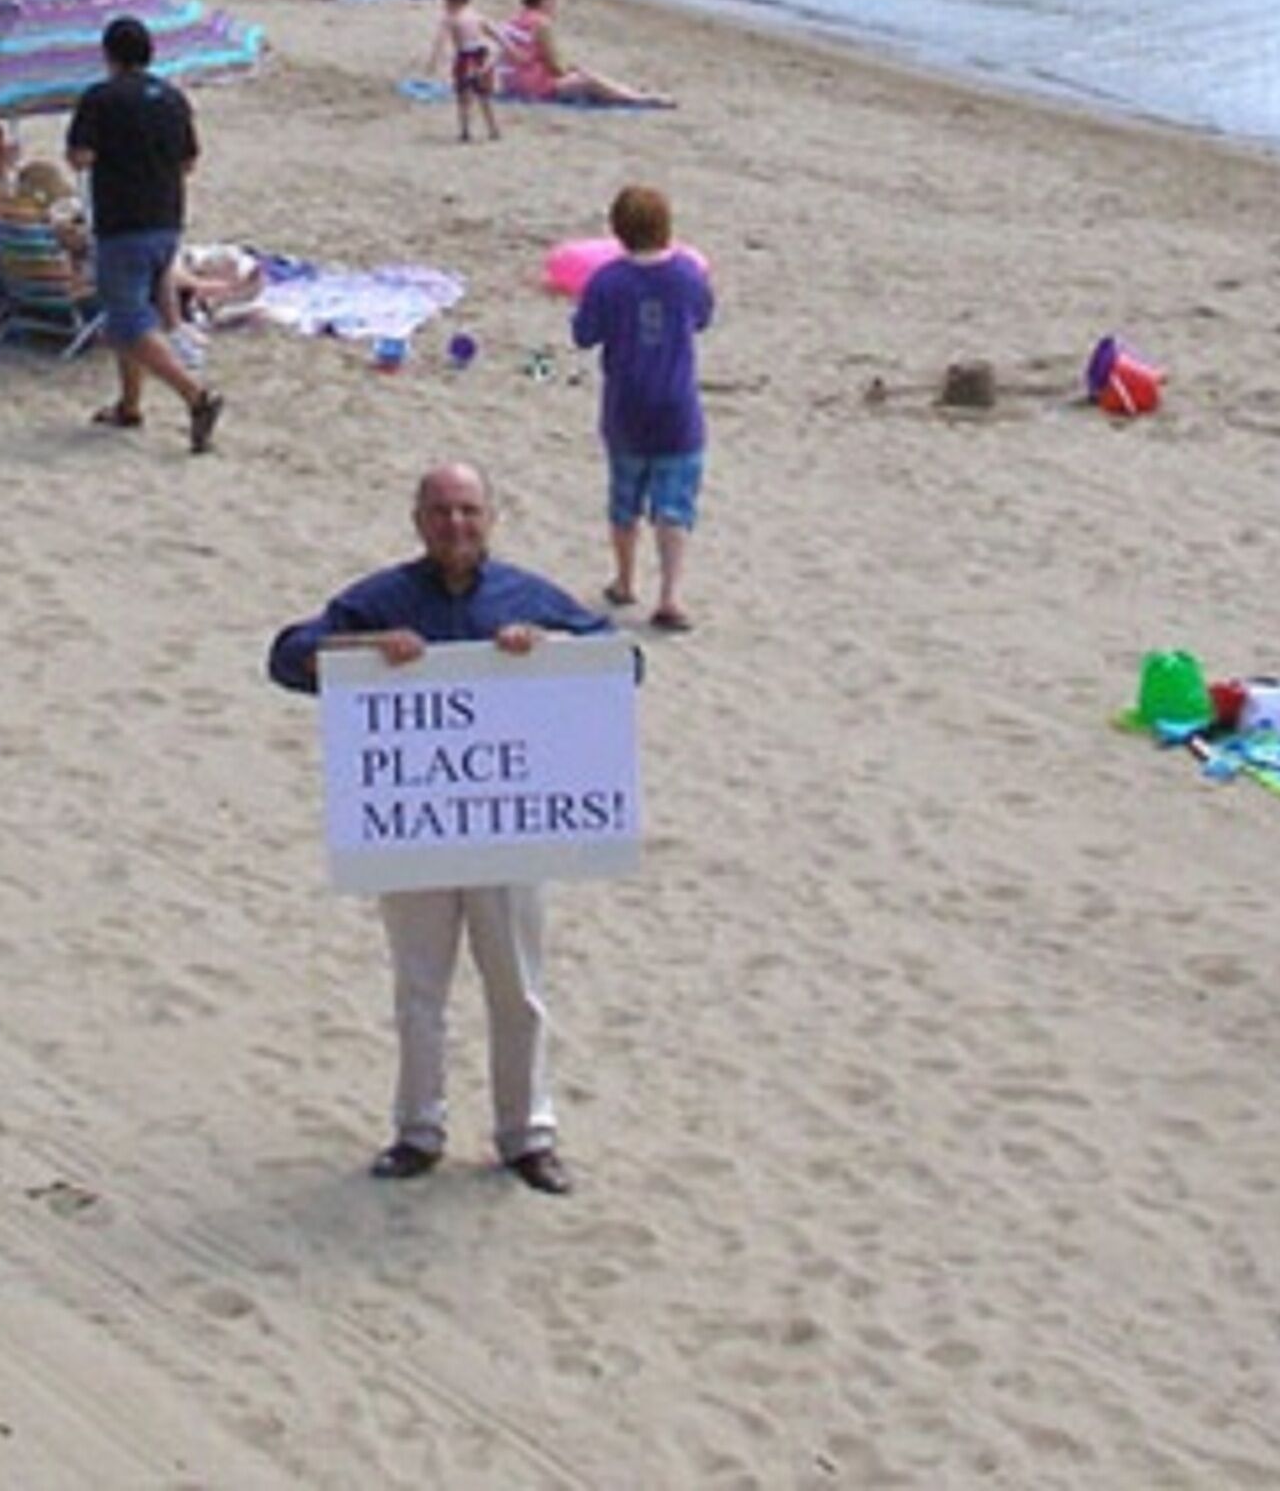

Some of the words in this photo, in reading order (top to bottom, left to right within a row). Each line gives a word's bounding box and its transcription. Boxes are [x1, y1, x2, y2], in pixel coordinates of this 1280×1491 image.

[356, 688, 476, 733] THIS
[360, 739, 531, 787] PLACE
[361, 790, 625, 840] MATTERS!
